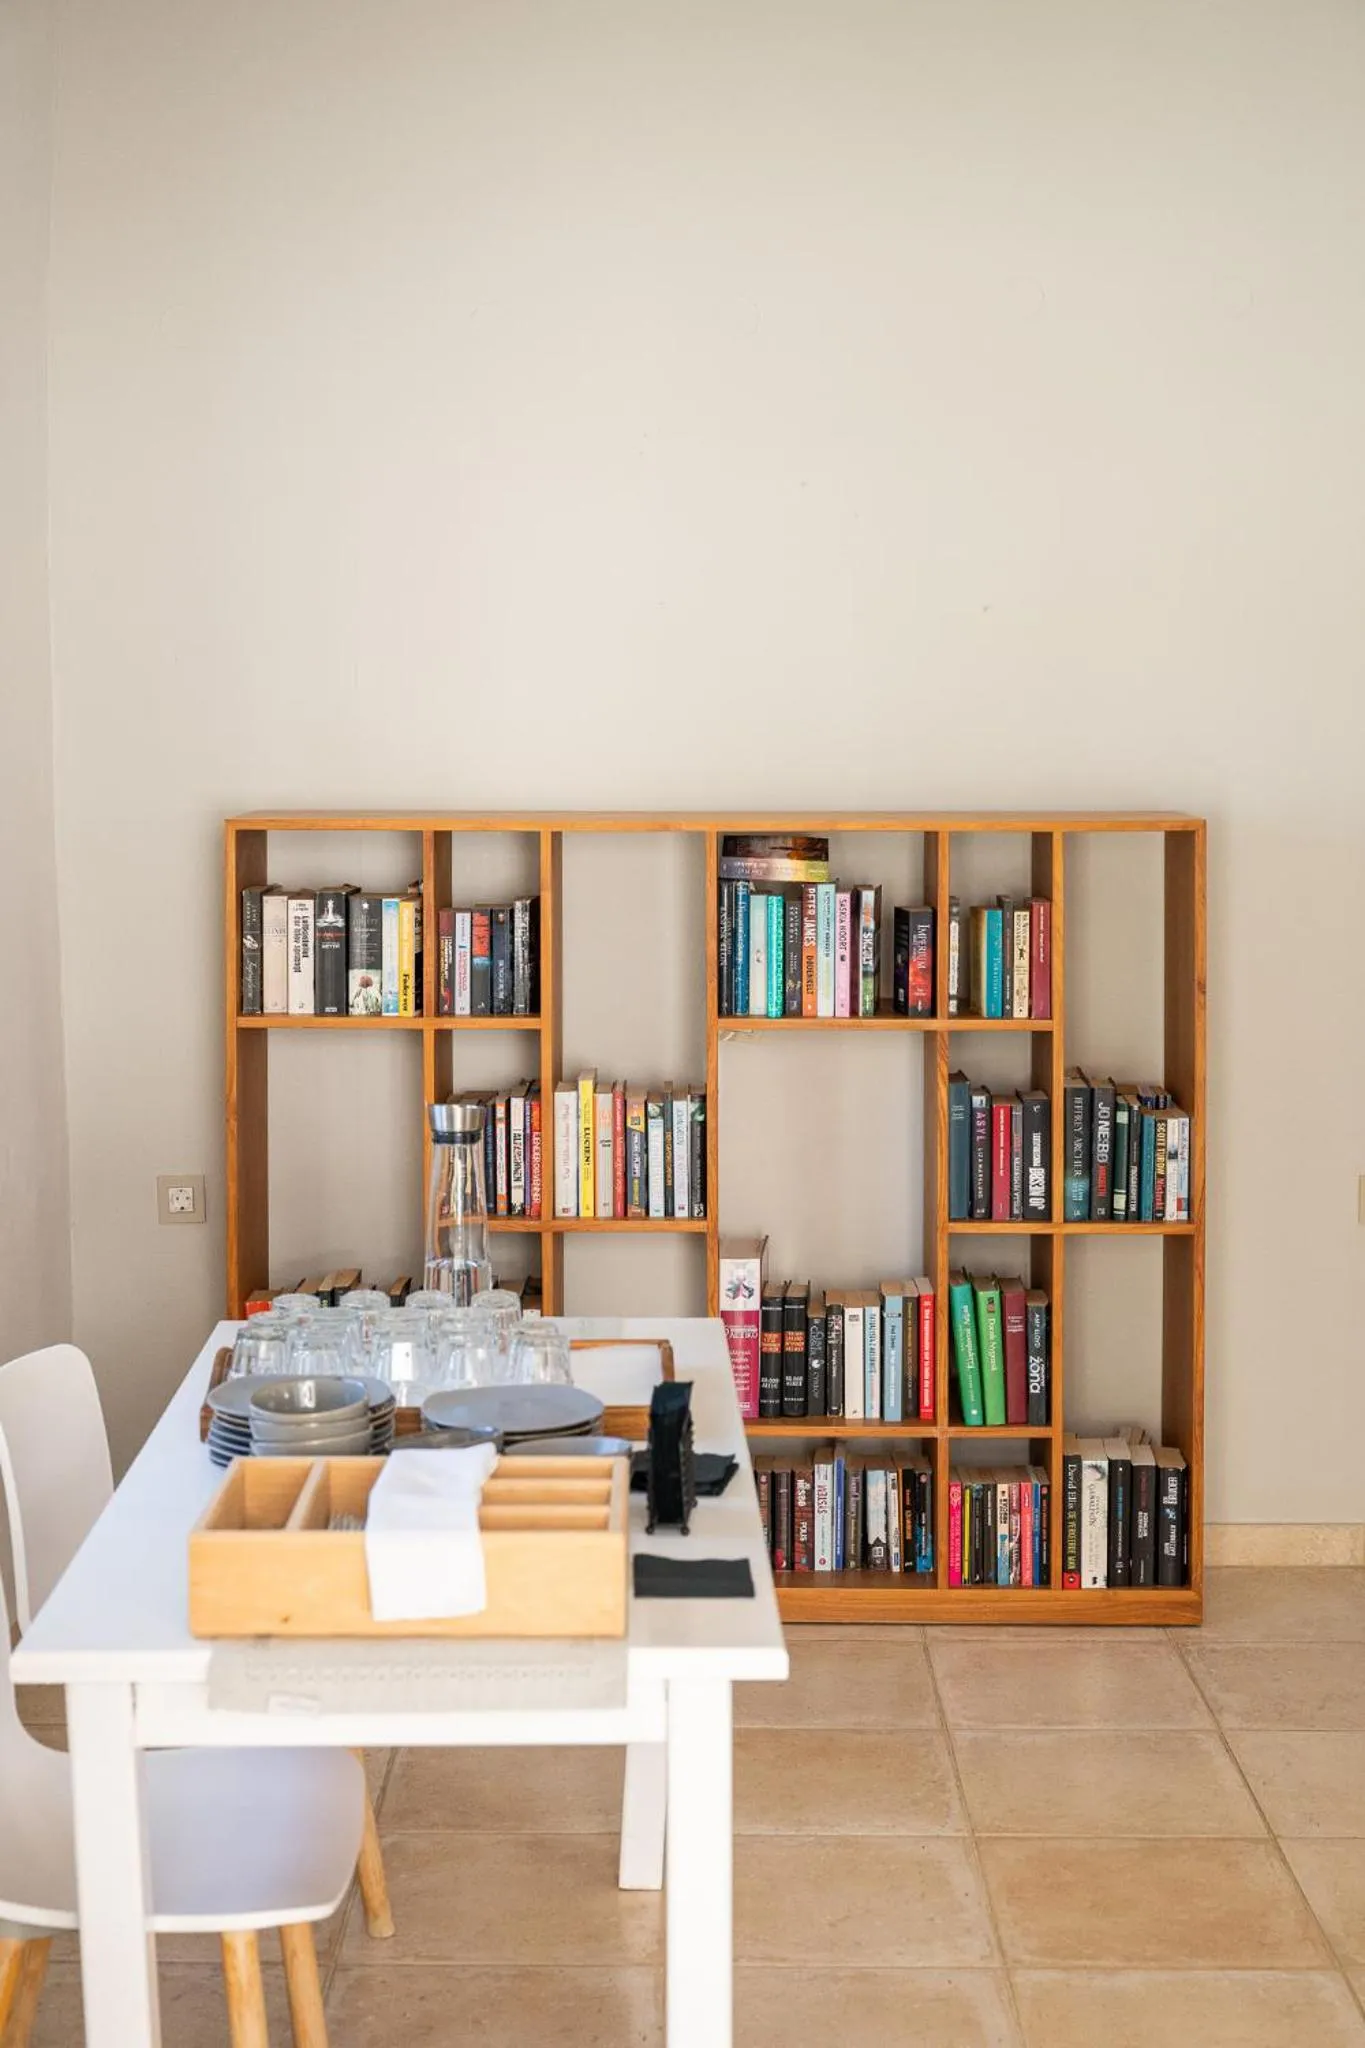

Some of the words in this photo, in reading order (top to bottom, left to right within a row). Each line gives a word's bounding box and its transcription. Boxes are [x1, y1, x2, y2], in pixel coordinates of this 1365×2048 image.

[808, 888, 816, 915] PETER
[803, 917, 815, 947] JAMES
[1098, 1102, 1109, 1119] JO
[976, 1112, 986, 1143] ASYL
[1156, 1122, 1166, 1147] SCOTT
[1156, 1148, 1165, 1175] TUROW
[1029, 1356, 1043, 1394] żona
[1068, 1464, 1078, 1489] David
[1068, 1491, 1078, 1510] Ellis
